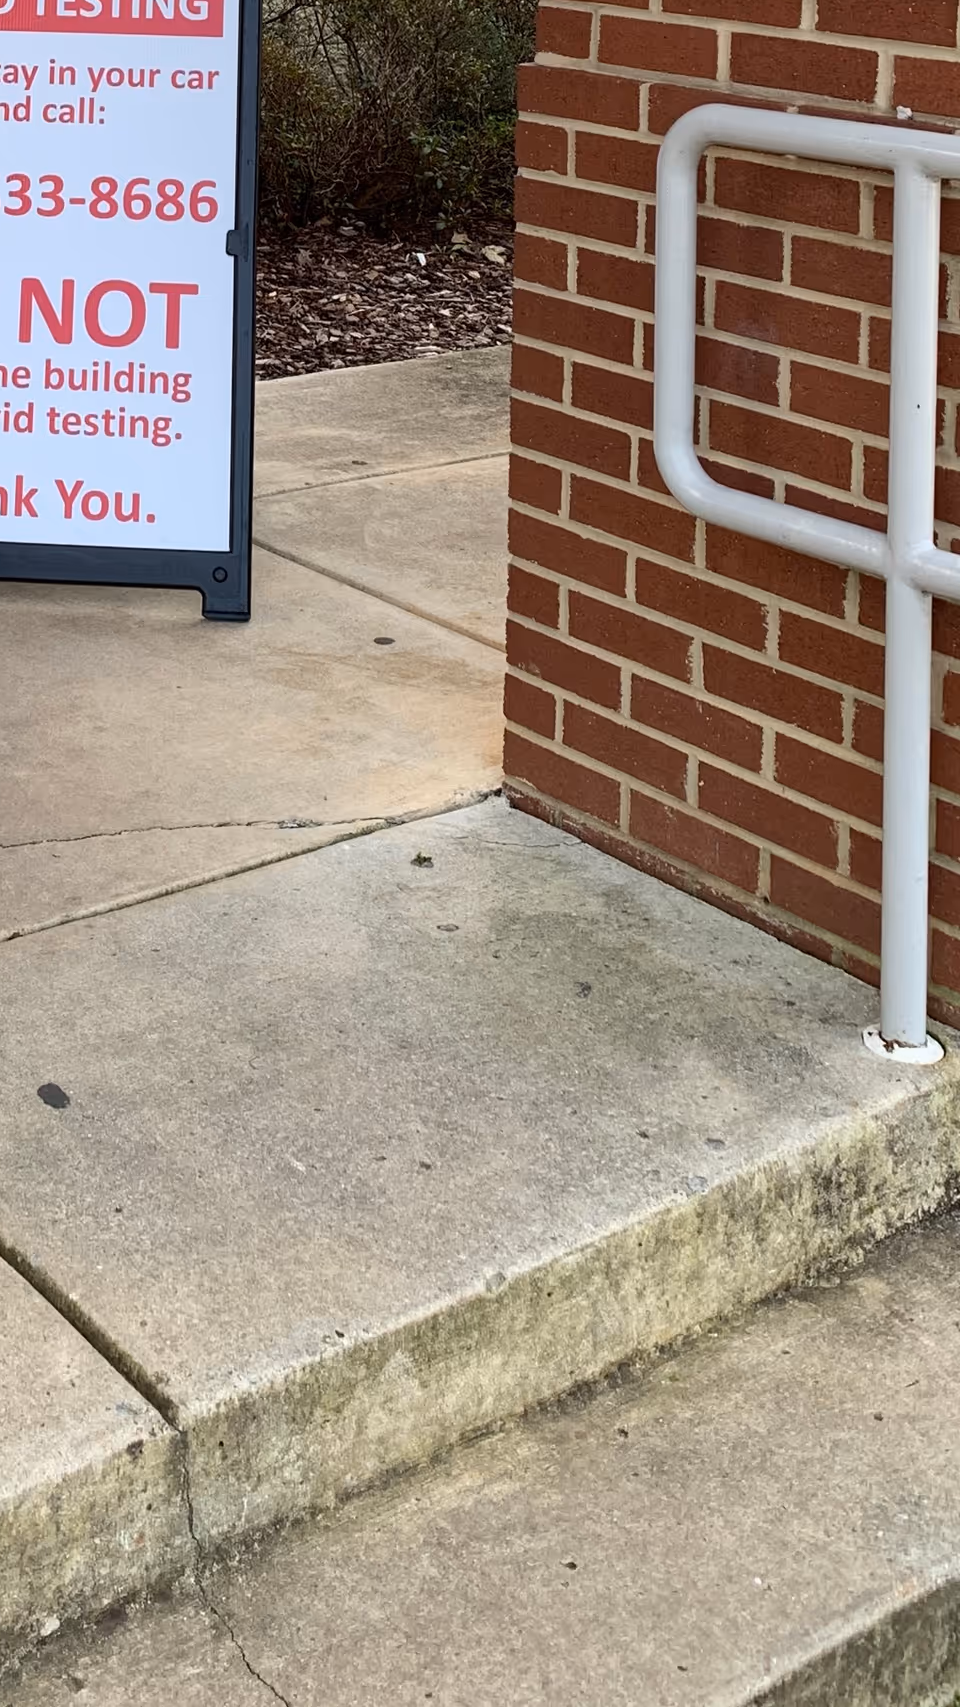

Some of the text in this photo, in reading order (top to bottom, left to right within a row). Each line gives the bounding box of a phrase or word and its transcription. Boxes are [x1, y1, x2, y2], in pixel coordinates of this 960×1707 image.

[48, 58, 77, 86] in
[87, 66, 162, 93] your
[170, 70, 221, 90] car
[41, 97, 107, 125] call:
[18, 277, 200, 350] NOT
[44, 358, 193, 403] building
[47, 403, 184, 447] testing.
[54, 478, 158, 525] You.
